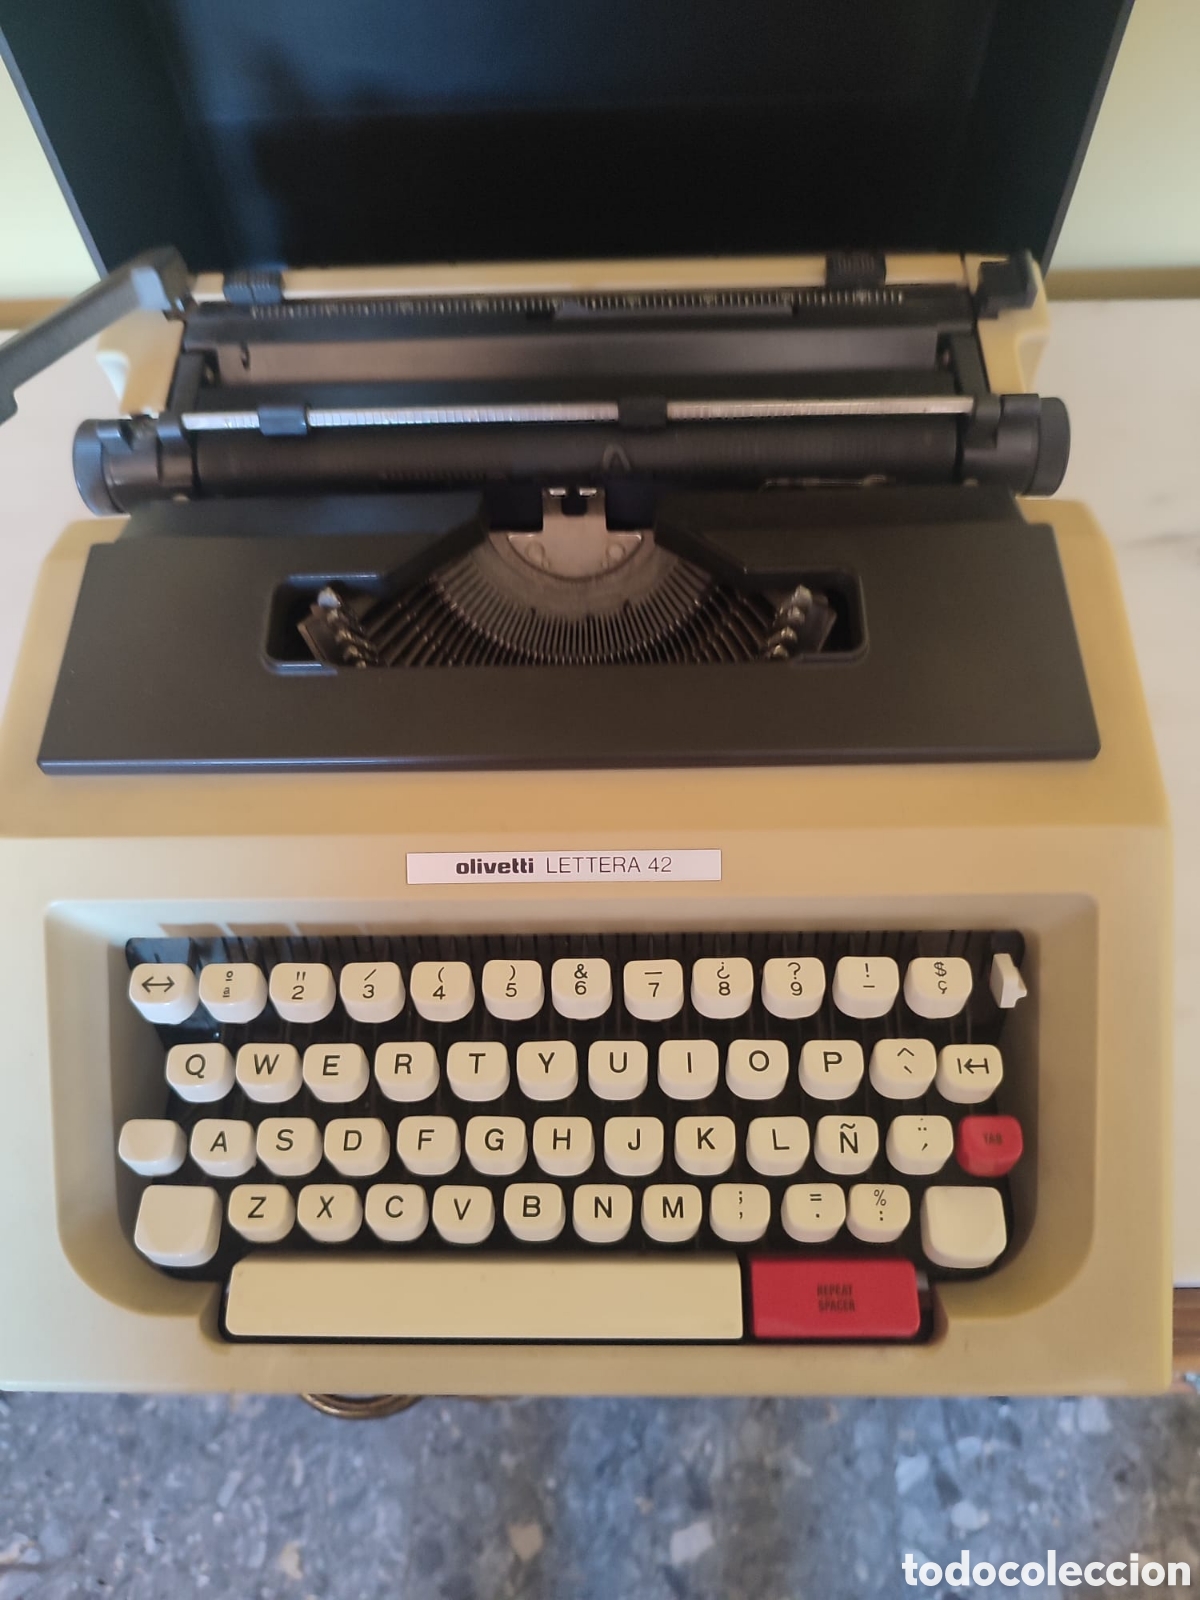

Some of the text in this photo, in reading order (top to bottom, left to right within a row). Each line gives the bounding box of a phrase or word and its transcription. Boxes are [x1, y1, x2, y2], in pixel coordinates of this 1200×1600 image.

[456, 857, 671, 874] olivetti LETTERA 42
[364, 969, 376, 981] /
[437, 967, 445, 982] (
[508, 965, 516, 980] )
[574, 964, 588, 979] &
[717, 962, 730, 979] ¿
[788, 962, 800, 979] ?
[864, 963, 870, 977] !
[934, 962, 946, 976] $
[292, 986, 304, 999] 2
[363, 984, 374, 998] 3
[433, 986, 445, 999] 4
[506, 983, 517, 997] 5
[575, 981, 586, 995] 6
[649, 983, 659, 997] 7
[719, 982, 730, 996] 8
[791, 982, 802, 996] 9
[938, 981, 947, 994] ç
[186, 1054, 205, 1078] Q
[254, 1054, 279, 1074] W
[323, 1055, 340, 1075] E
[395, 1054, 412, 1074] R
[469, 1053, 486, 1074] T
[538, 1052, 554, 1073] Y
[610, 1052, 627, 1073] U
[687, 1052, 692, 1073] I
[749, 1050, 769, 1071] O
[823, 1052, 842, 1072] P
[210, 1131, 227, 1152] A
[276, 1129, 293, 1151] S
[344, 1130, 362, 1151] D
[418, 1129, 434, 1150] F
[485, 1129, 503, 1151] G
[553, 1129, 570, 1150] H
[628, 1129, 640, 1150] J
[698, 1128, 715, 1149] K
[772, 1129, 789, 1150] L
[840, 1123, 858, 1153] Ñ
[248, 1197, 266, 1218] Z
[317, 1196, 334, 1218] X
[386, 1196, 403, 1218] C
[523, 1196, 540, 1217] B
[595, 1197, 612, 1218] N
[663, 1197, 683, 1218] M
[874, 1190, 886, 1206] %
[454, 1199, 471, 1220] V
